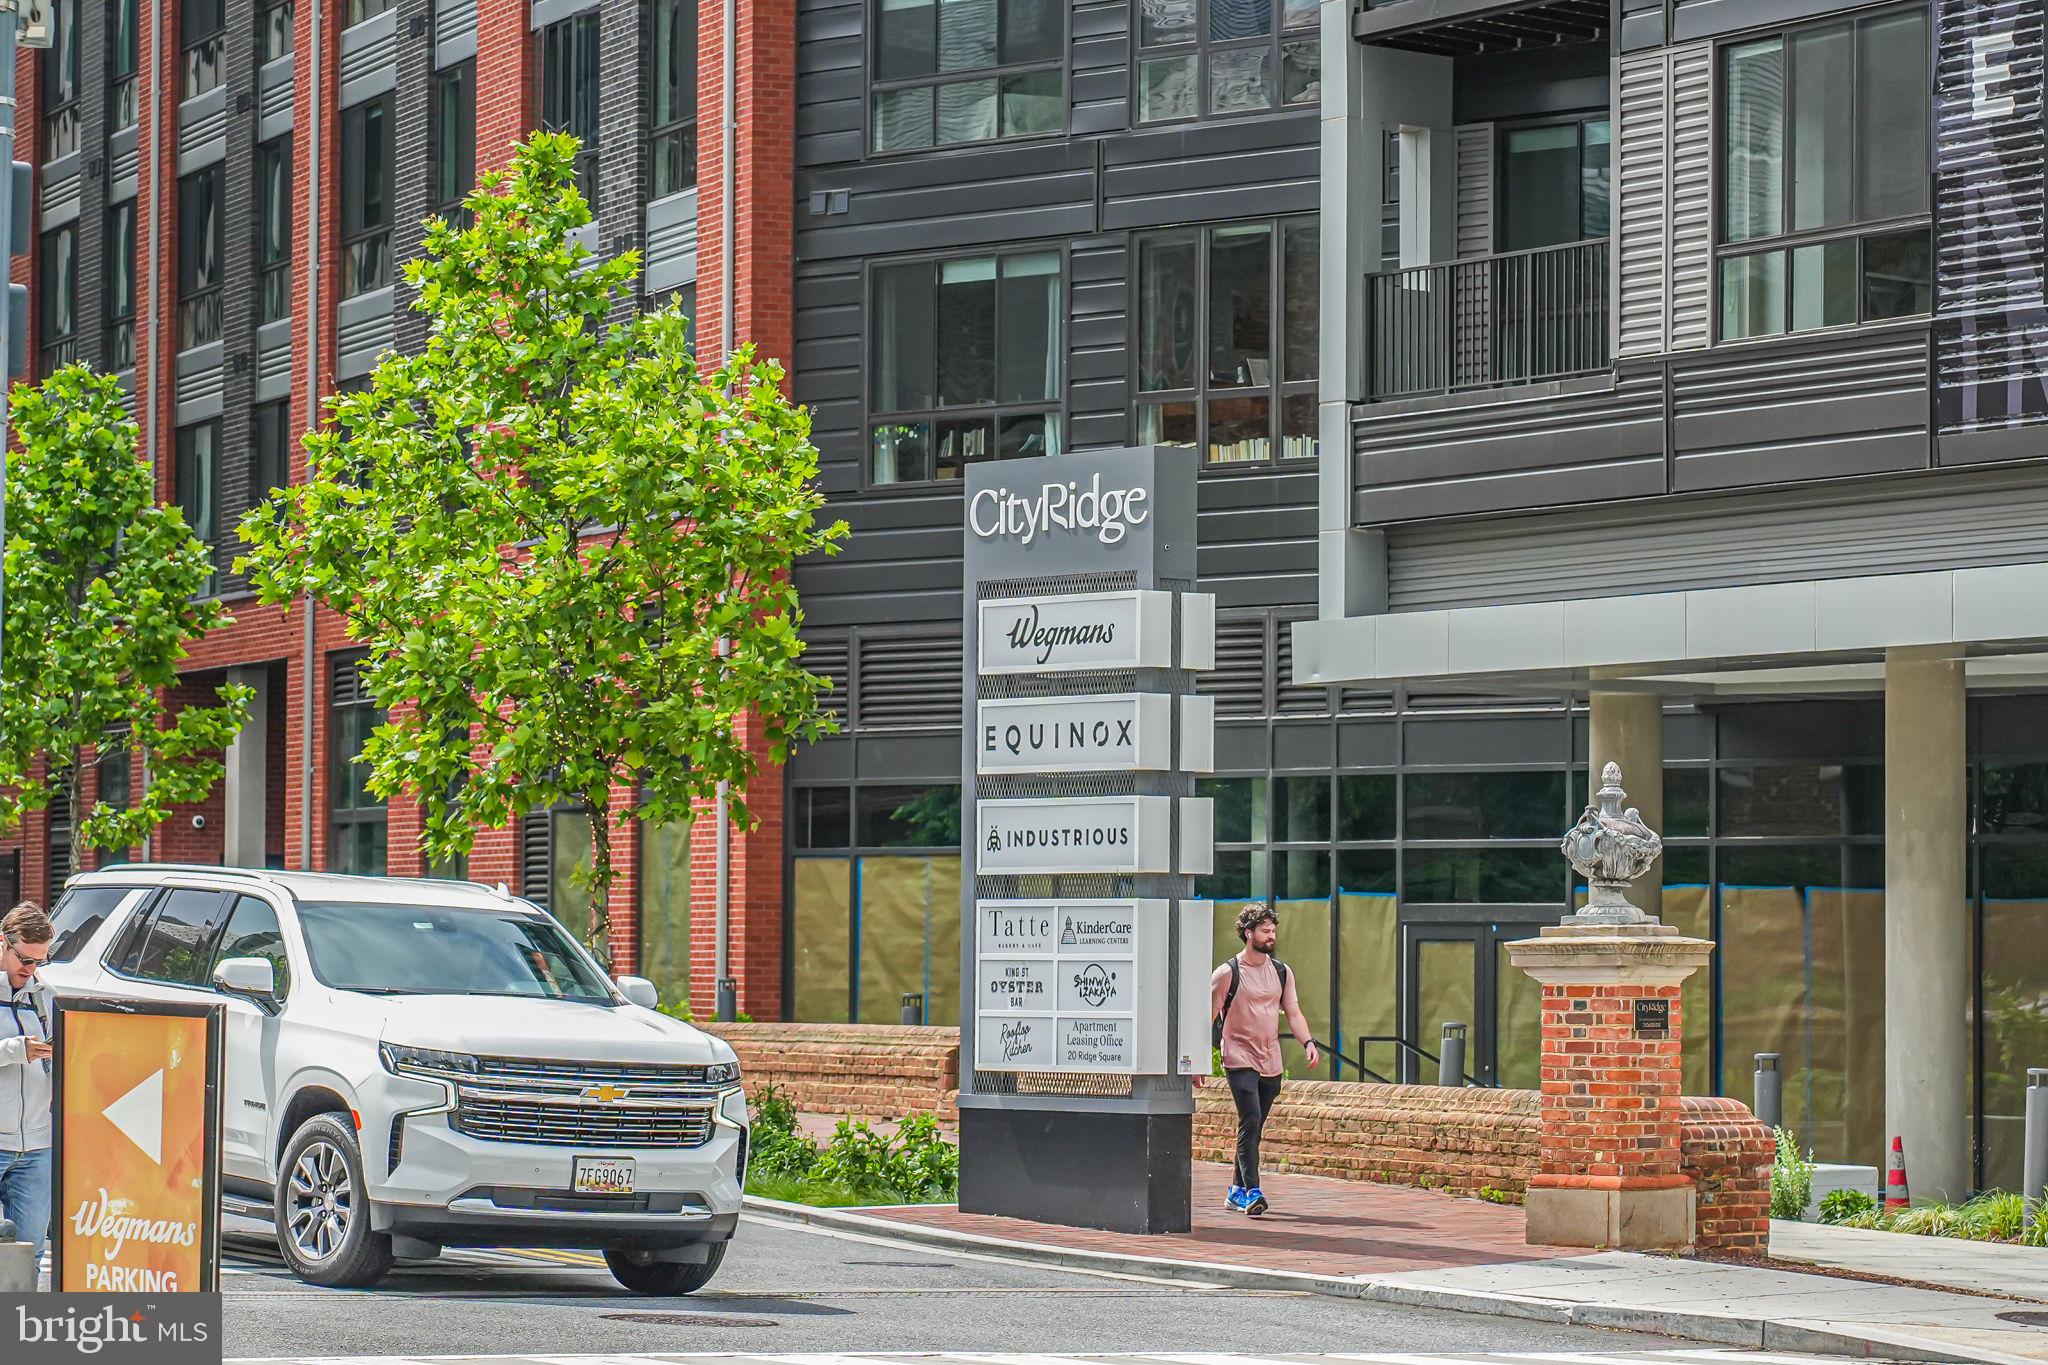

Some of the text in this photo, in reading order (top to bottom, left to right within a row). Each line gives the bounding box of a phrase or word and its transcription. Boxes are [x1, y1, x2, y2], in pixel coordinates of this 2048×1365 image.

[969, 472, 1148, 544] CityRidge
[1006, 604, 1115, 664] Wegmans
[985, 720, 1132, 755] EQUINOX
[1007, 827, 1128, 848] INDUSTRIOUS
[988, 910, 1049, 937] Tatte
[1076, 920, 1132, 934] KinderCare
[1079, 937, 1129, 945] LEARNING CENTERS
[1005, 967, 1029, 978] KING ST
[991, 981, 1044, 994] OYSTER
[1073, 974, 1111, 988] SHINWA
[1079, 986, 1117, 998] IZAKAYA
[1010, 997, 1023, 1007] BAR
[1000, 1020, 1032, 1044] Rooftop
[1072, 1020, 1117, 1034] Apartment
[1066, 1034, 1124, 1048] Leasing Office
[1002, 1039, 1033, 1062] Kitchen
[1067, 1050, 1122, 1063] 20 Ridge Square
[69, 1187, 197, 1261] Wegmans
[86, 1263, 178, 1293] PARKING
